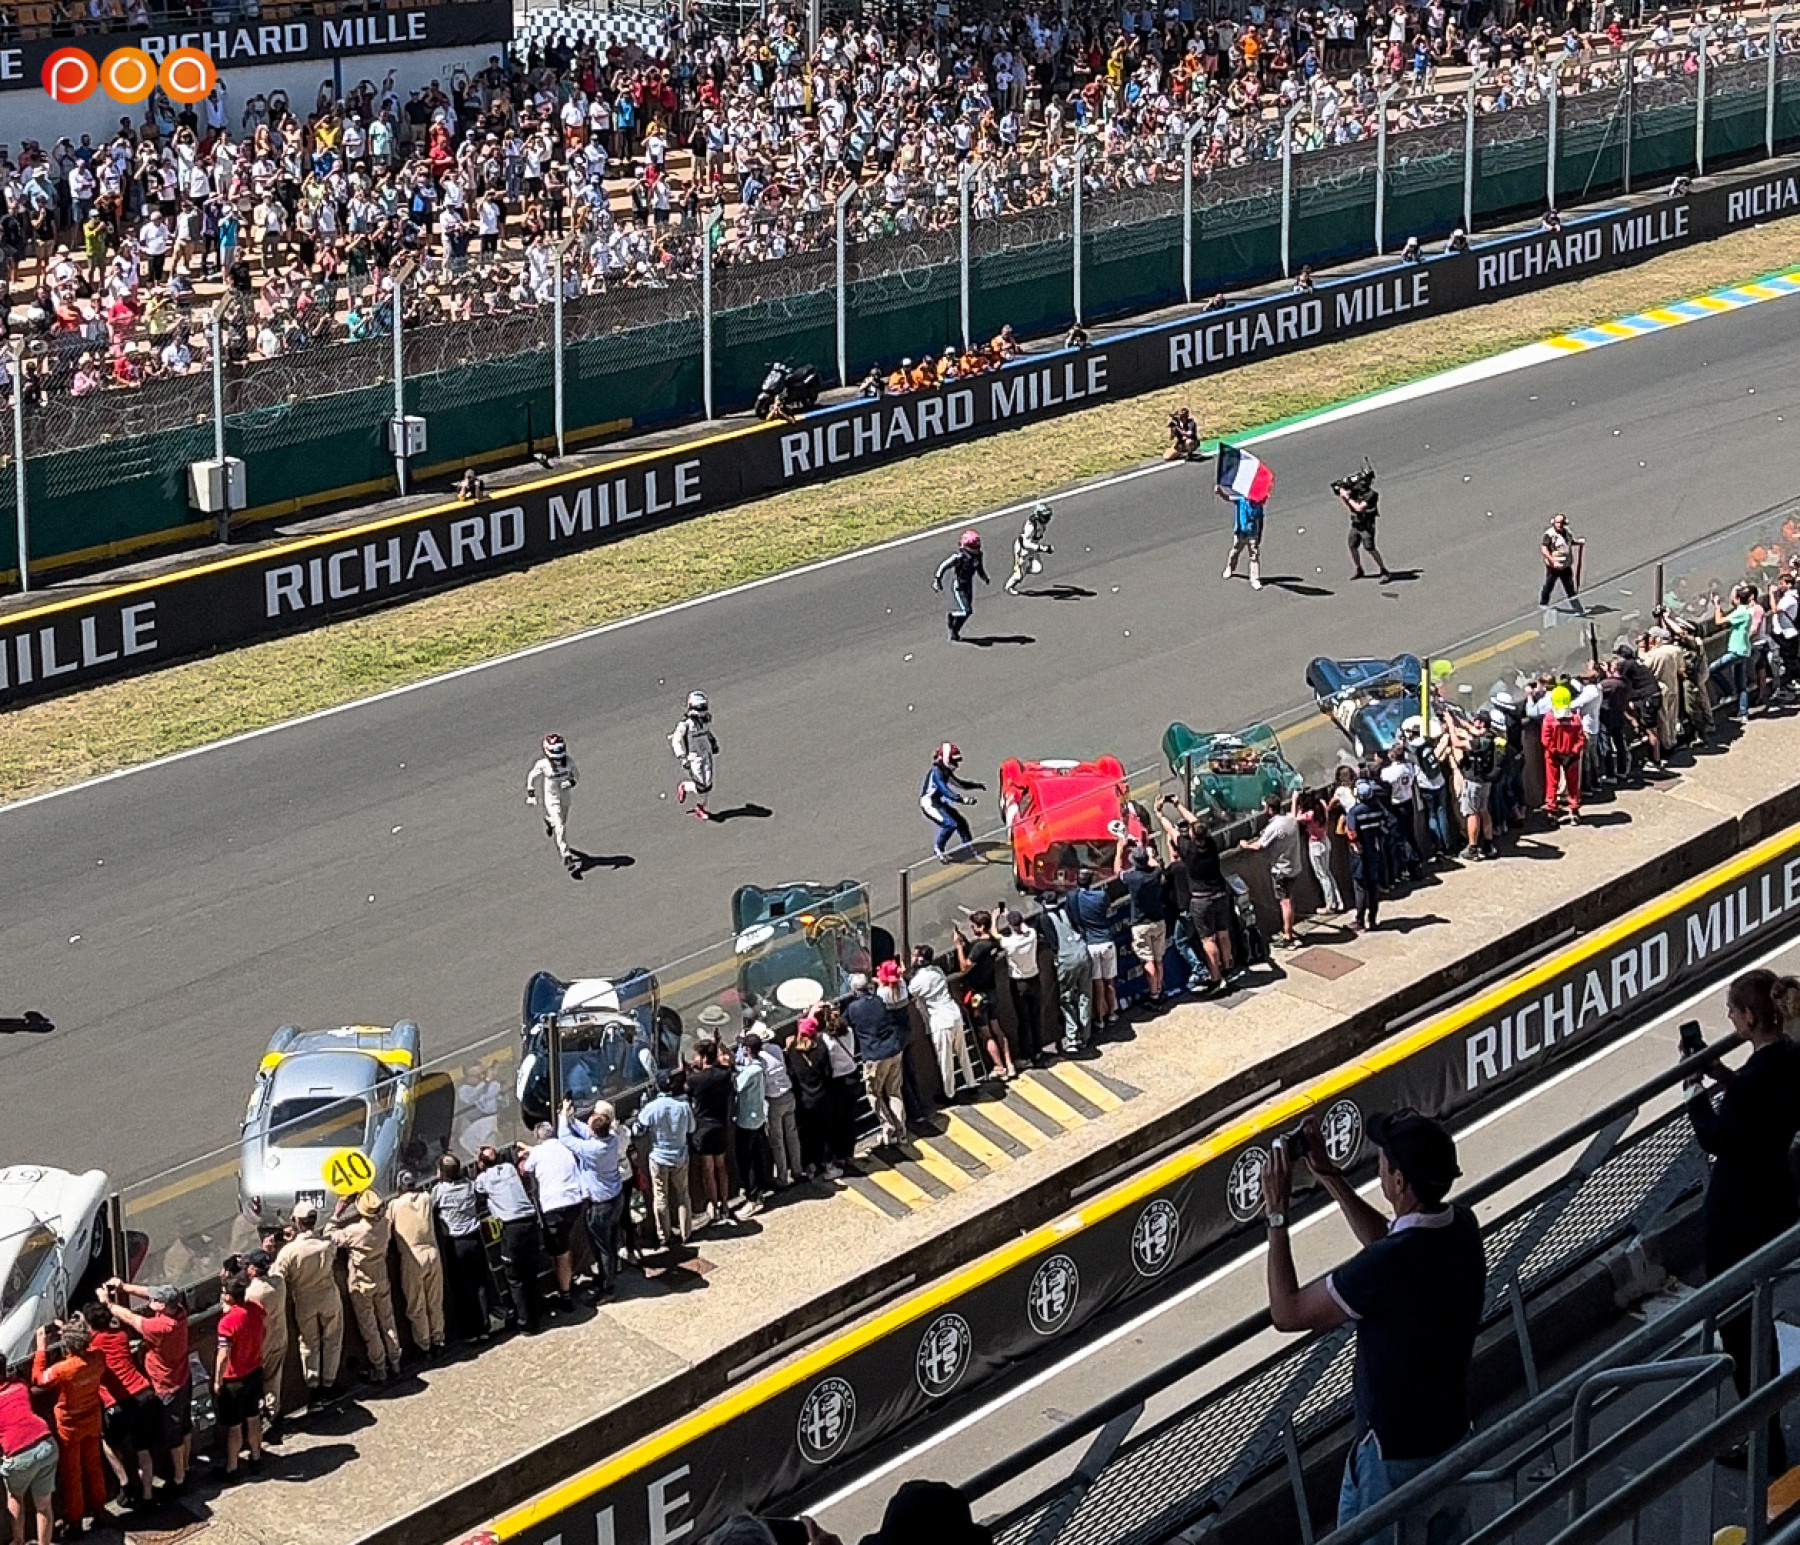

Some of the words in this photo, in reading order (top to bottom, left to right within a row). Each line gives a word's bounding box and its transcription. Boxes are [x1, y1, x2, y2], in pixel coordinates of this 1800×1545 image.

[323, 12, 427, 49] MILLE
[1728, 177, 1798, 223] RICHA
[1478, 228, 1603, 291] RICHARD
[1612, 205, 1690, 254] MILLE
[1169, 299, 1322, 373] RICHARD
[1335, 271, 1430, 328] MILLE
[780, 389, 974, 478] RICHARD
[991, 355, 1109, 421] MILLE
[264, 506, 526, 618] RICHARD
[548, 460, 703, 541] MILLE
[1466, 931, 1669, 1091] RICHARD
[1686, 857, 1800, 966] MILLE
[331, 1152, 372, 1187] 40
